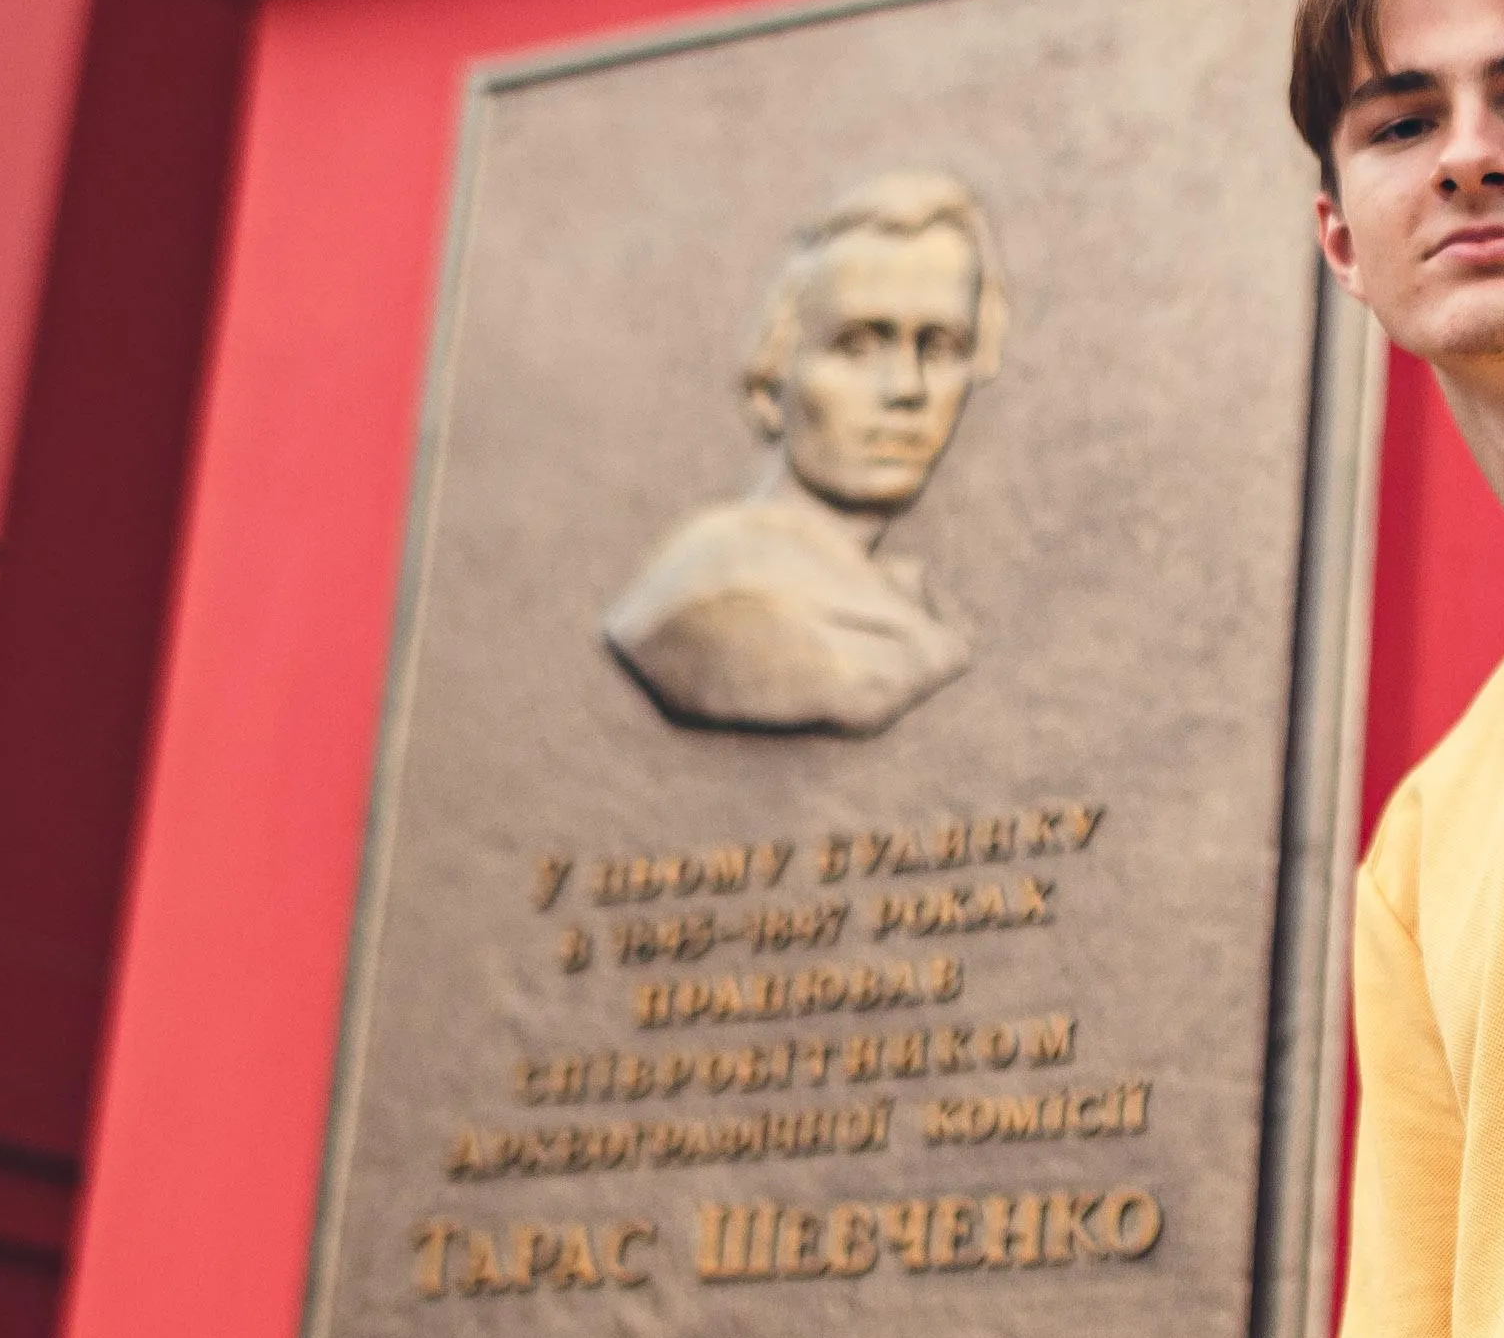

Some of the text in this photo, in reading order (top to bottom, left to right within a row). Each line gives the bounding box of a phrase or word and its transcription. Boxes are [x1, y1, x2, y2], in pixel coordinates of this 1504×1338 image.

[818, 804, 1104, 882] БУДИНКУ
[871, 873, 1056, 941] РОКАХ
[634, 956, 964, 1028] ПРАЦЮВАВ
[512, 1015, 1078, 1104] СПІВРОБІТНИКОМ
[921, 1081, 1152, 1145] КОМІСІЇ
[698, 1191, 1164, 1285] ШЕВЧЕНКО
